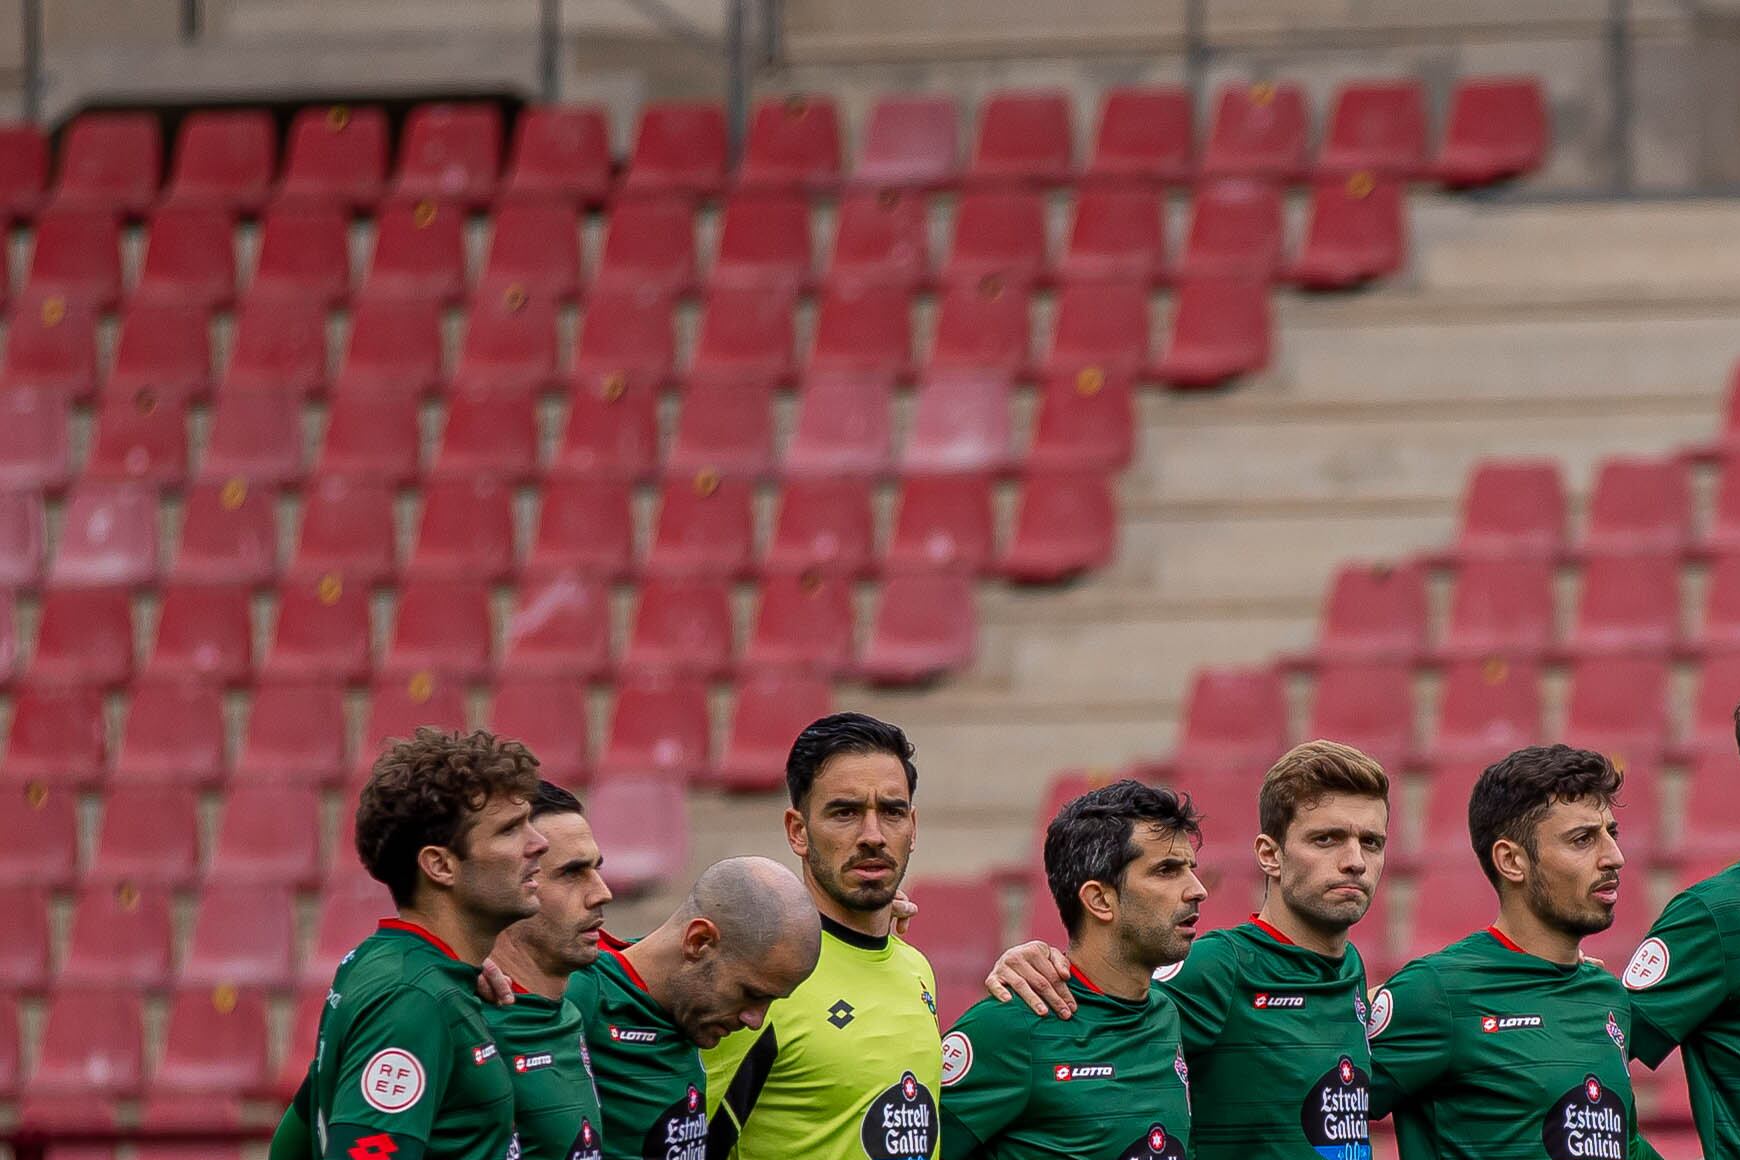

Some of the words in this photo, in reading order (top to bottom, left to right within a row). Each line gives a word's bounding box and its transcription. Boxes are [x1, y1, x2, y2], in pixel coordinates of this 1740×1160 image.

[1267, 997, 1304, 1006] LOTTO
[1499, 1016, 1541, 1027] LOTTO
[619, 1031, 657, 1041] LOTTO
[1072, 1066, 1113, 1077] LOTTO
[1321, 1087, 1368, 1113] Estrella
[1563, 1103, 1622, 1132] Estrella
[885, 1128, 928, 1155] Galici
[1567, 1130, 1622, 1160] Galicia
